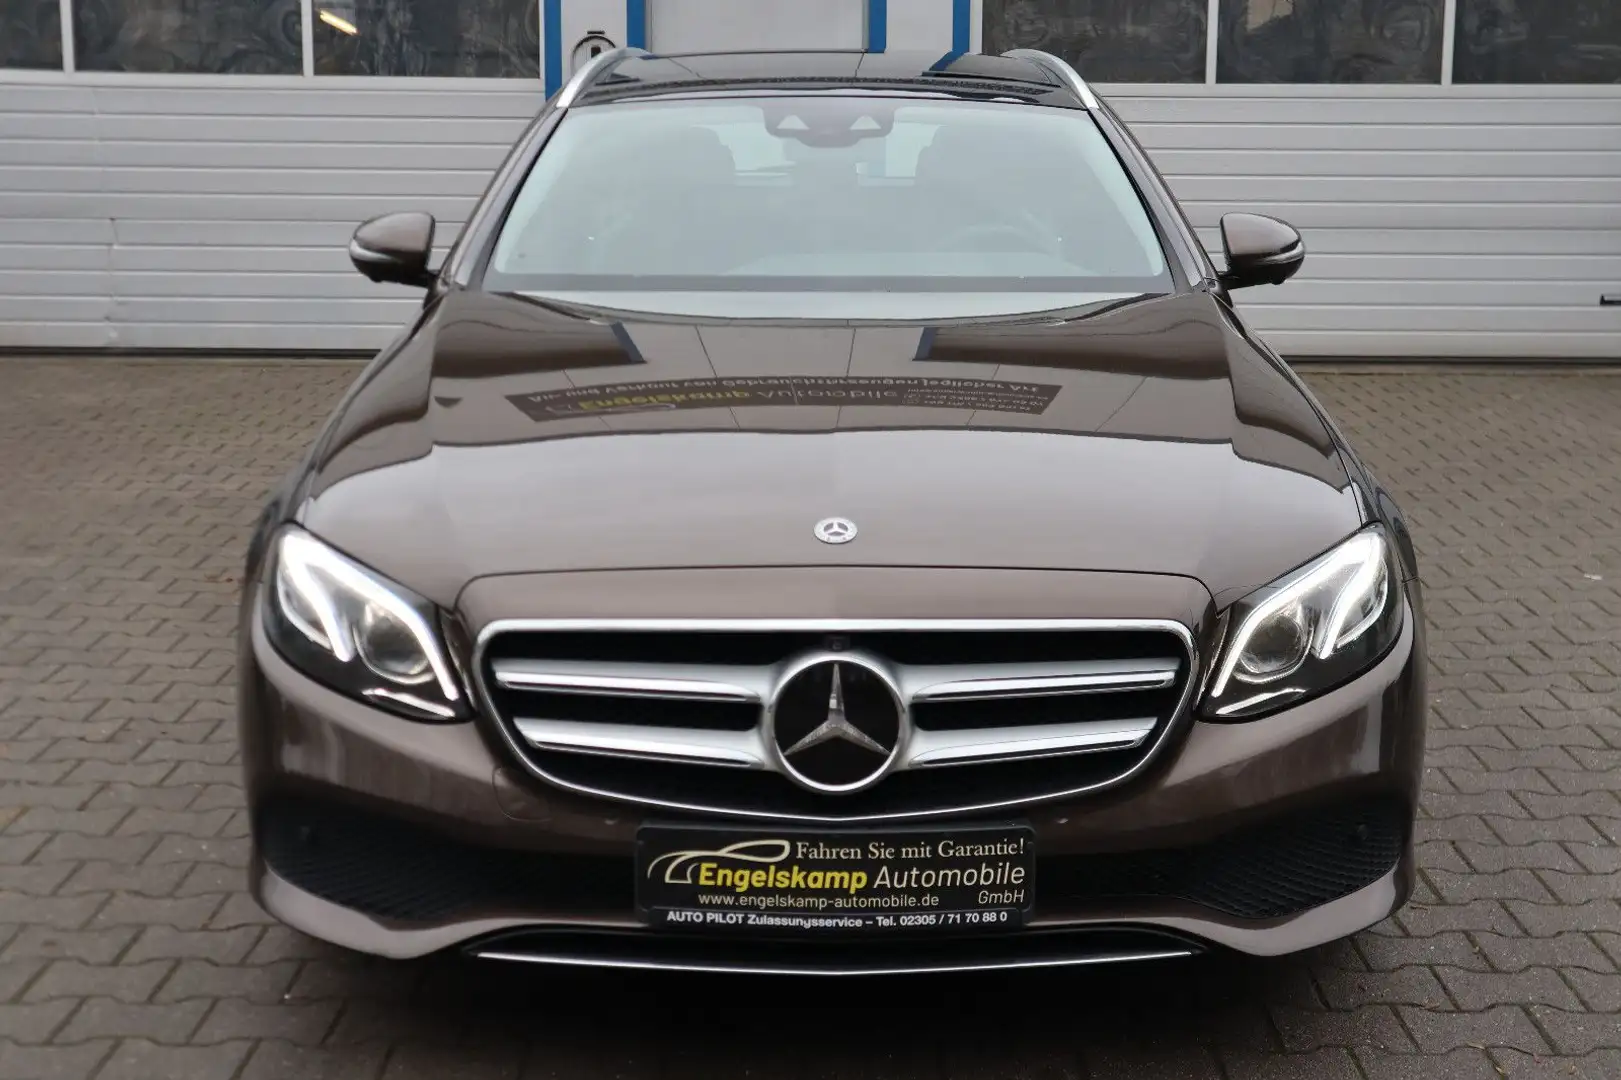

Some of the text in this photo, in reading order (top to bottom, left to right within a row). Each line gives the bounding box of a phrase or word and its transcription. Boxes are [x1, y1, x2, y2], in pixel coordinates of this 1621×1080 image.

[796, 838, 1025, 860] Fahren Sie mit Garantie!
[698, 861, 1026, 895] Engelskamp Automobile
[698, 893, 940, 910] www.engelskamp-automobile.de
[978, 888, 1025, 905] GmbH
[667, 910, 704, 924] AUTO
[706, 911, 744, 925] PILOT
[747, 913, 863, 929] Zulassungsservice
[876, 915, 897, 927] Tel.
[900, 913, 937, 927] 02305
[939, 913, 945, 926] /
[947, 912, 962, 925] 71
[965, 911, 980, 924] 70
[982, 910, 998, 923] 88
[999, 909, 1008, 923] 0
